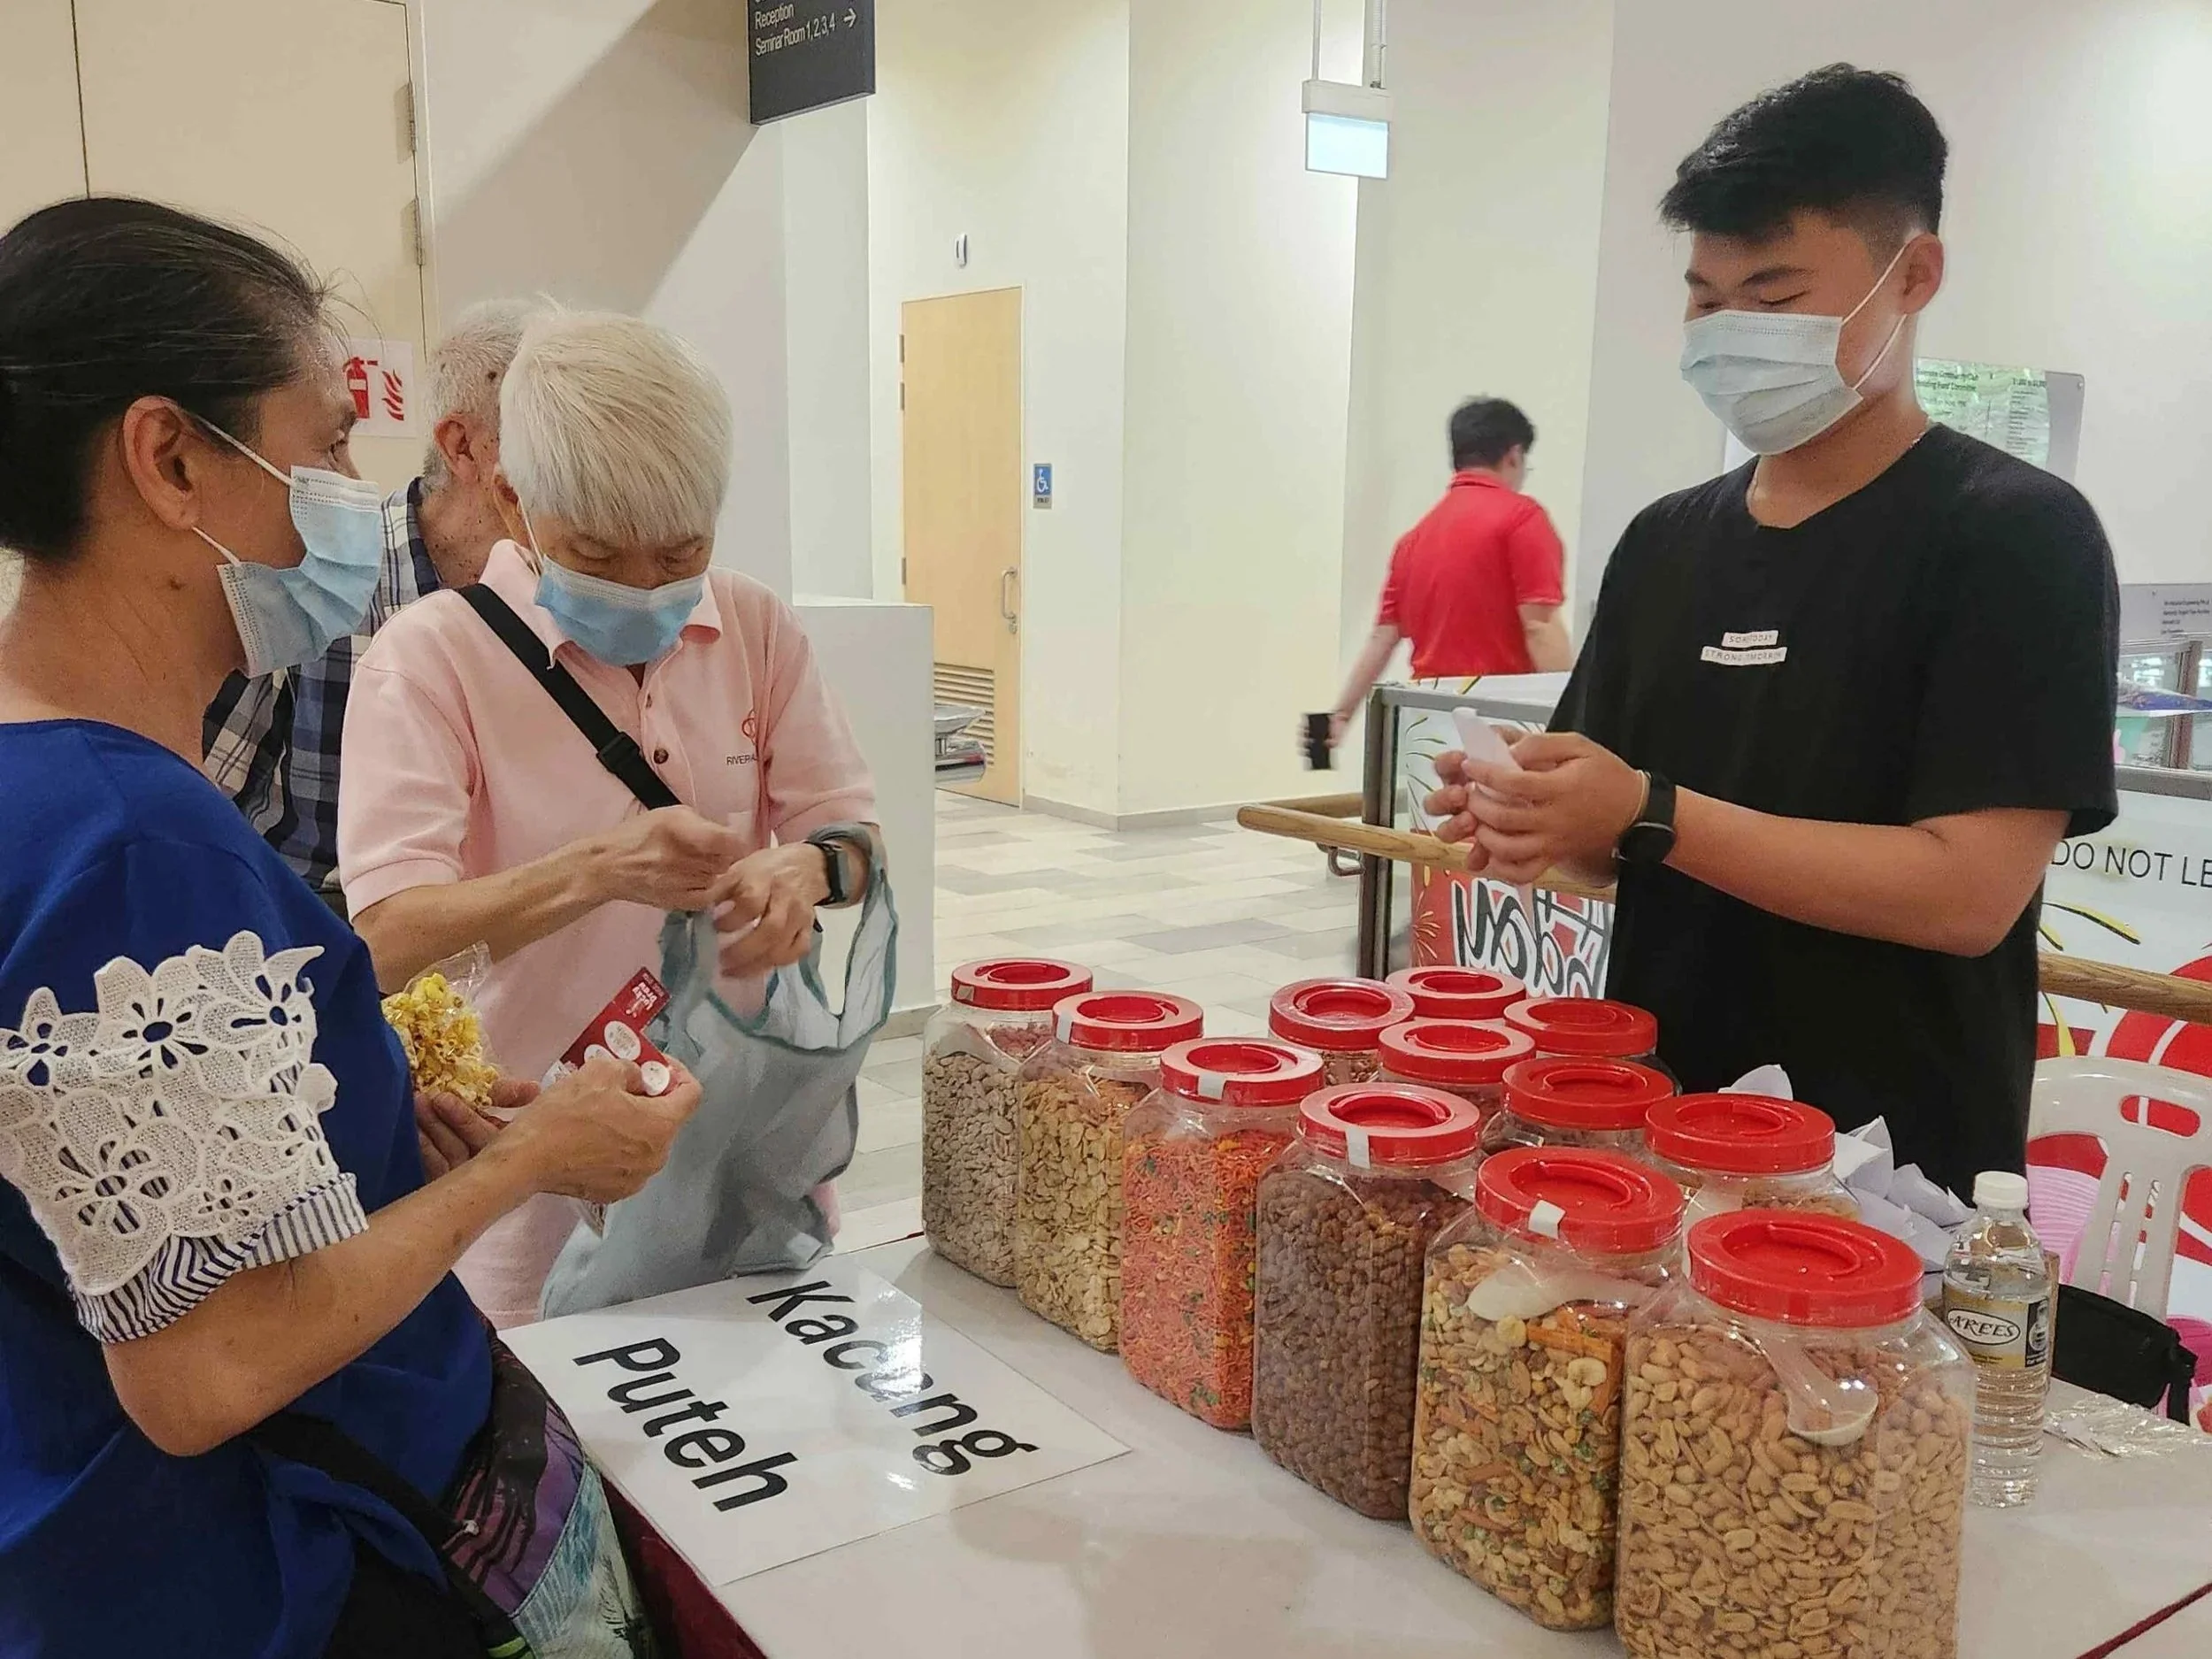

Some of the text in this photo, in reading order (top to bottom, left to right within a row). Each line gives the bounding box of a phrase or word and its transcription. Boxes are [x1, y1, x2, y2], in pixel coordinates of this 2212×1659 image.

[755, 4, 795, 29] Reception
[756, 34, 784, 57] Seminar
[784, 27, 805, 47] Room
[2051, 840, 2212, 888] DO NOT LE
[1949, 1316, 2015, 1337] AREES
[746, 1280, 1039, 1476] Kacang
[573, 1337, 798, 1512] Puteh
